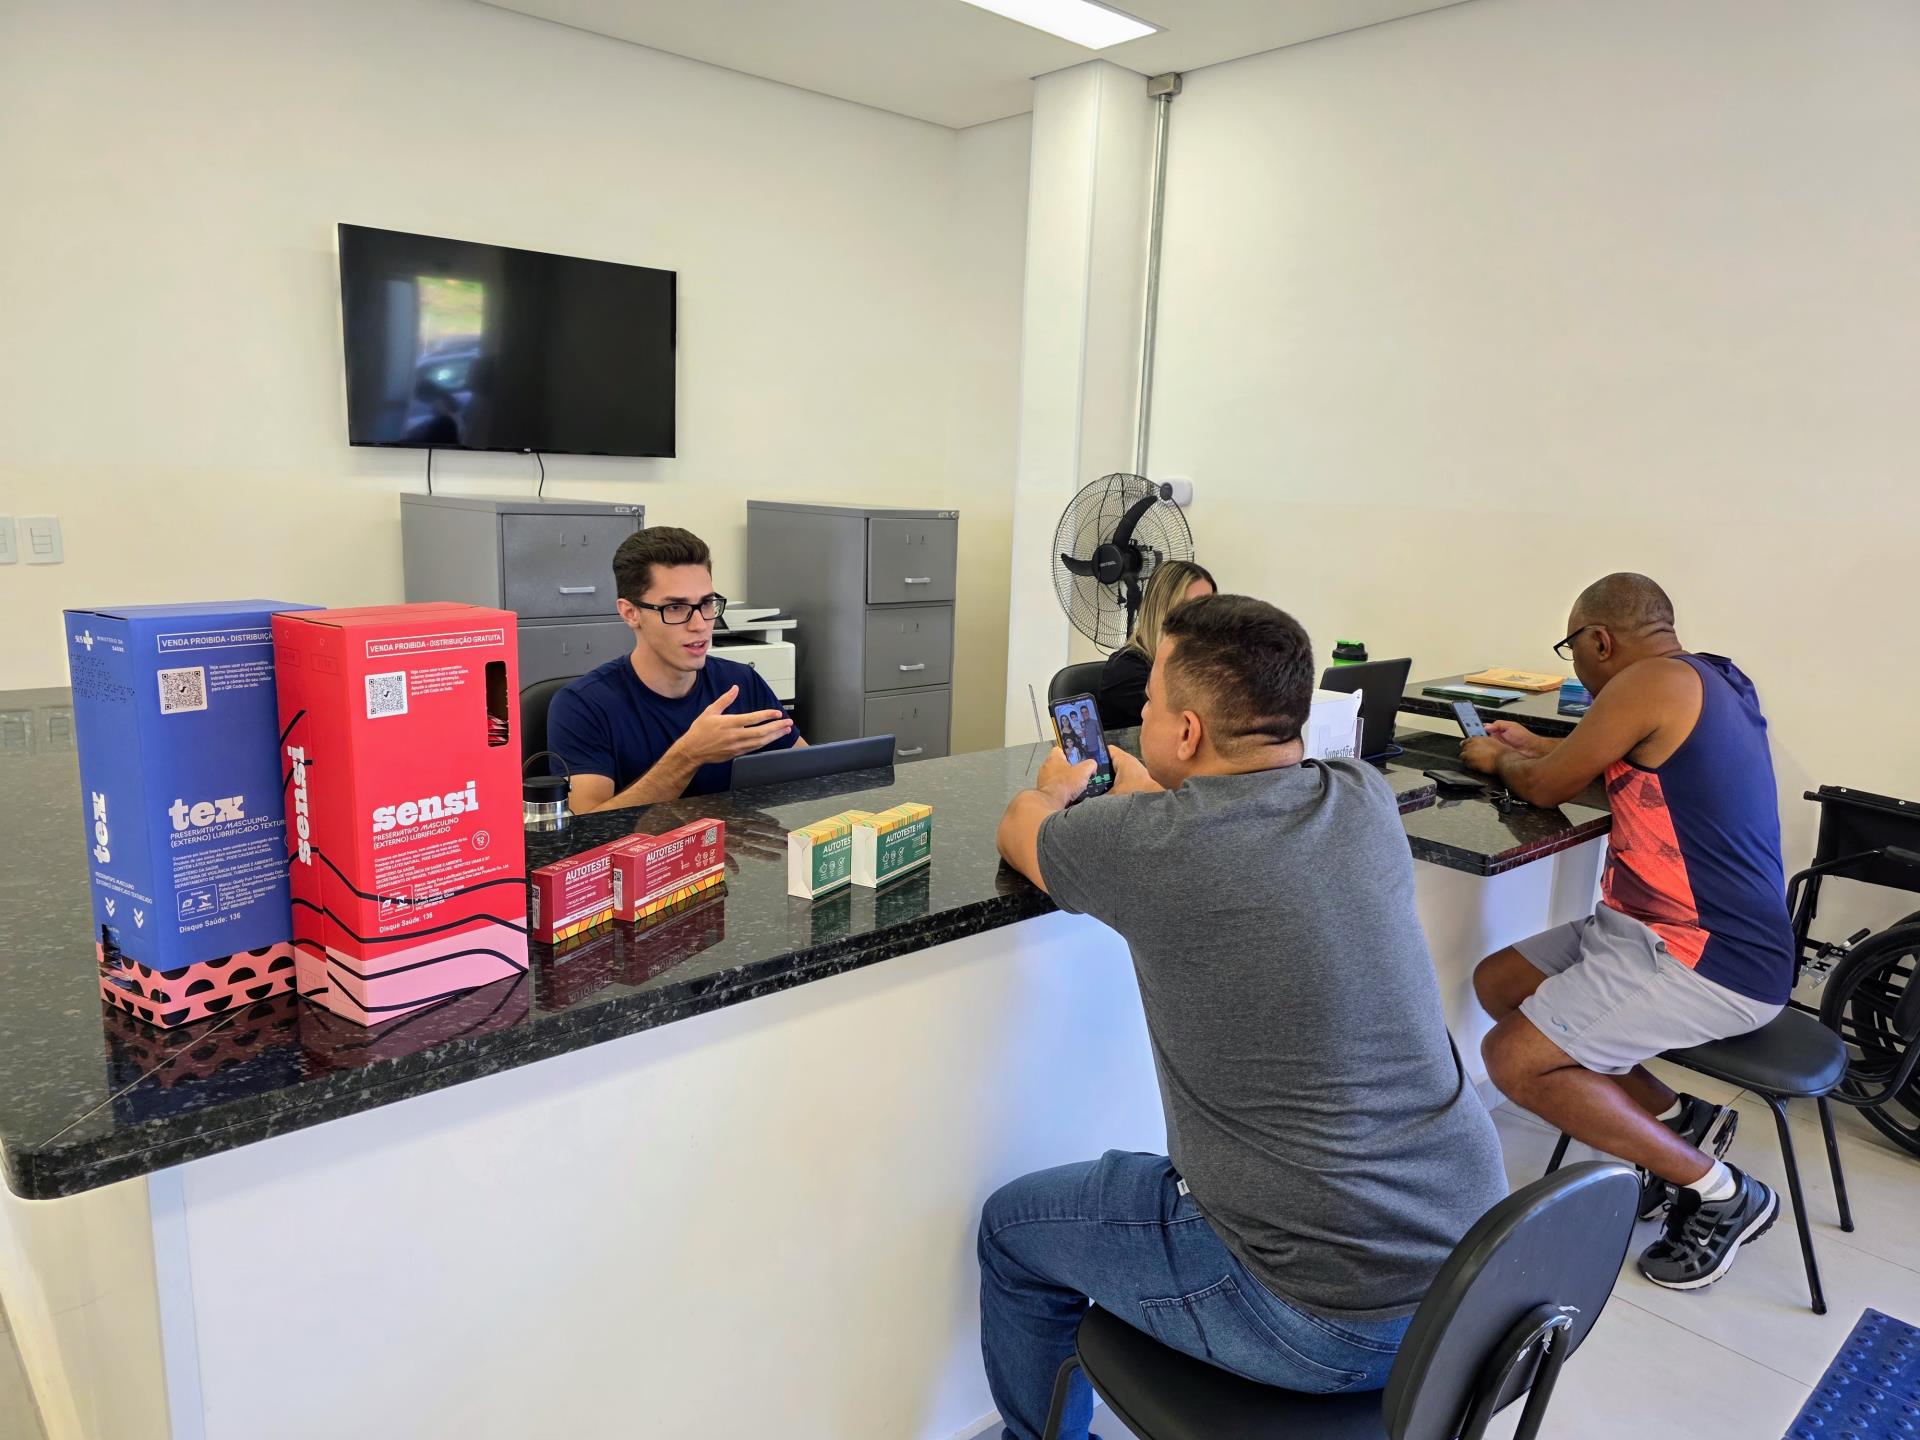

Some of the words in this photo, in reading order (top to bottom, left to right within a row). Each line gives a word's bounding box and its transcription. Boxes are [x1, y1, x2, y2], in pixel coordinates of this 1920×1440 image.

[161, 637, 189, 647] VENDA
[190, 635, 225, 645] PROIBIDA
[370, 643, 393, 652] VENDA
[394, 640, 425, 650] PROIBIDA
[429, 635, 471, 647] DISTRIBUIÇÃO
[472, 633, 500, 643] GRATUITA
[168, 796, 244, 830] tex
[287, 746, 312, 866] sensi
[373, 780, 479, 833] sensi
[92, 792, 110, 863] tex
[170, 824, 222, 840] PRESERVATIVO
[224, 815, 268, 829] MASCULINO
[170, 833, 210, 848] (EXTERNO)
[212, 823, 258, 840] LUBRIFICADO
[373, 825, 418, 841] PRESERVATIVO
[419, 817, 458, 831] MASCULINO
[373, 835, 408, 849] (EXTERNO)
[410, 826, 450, 841] LUBRIFICADO
[886, 825, 916, 844] AUTOTESTE
[916, 822, 926, 832] HIV
[646, 840, 684, 862] AUTOTESTE
[684, 834, 697, 846] HIV
[566, 856, 610, 881] AUTOTESTE
[179, 921, 203, 934] Disque
[204, 914, 227, 927] Saúde:
[229, 912, 240, 920] 136
[379, 921, 400, 934] Disque
